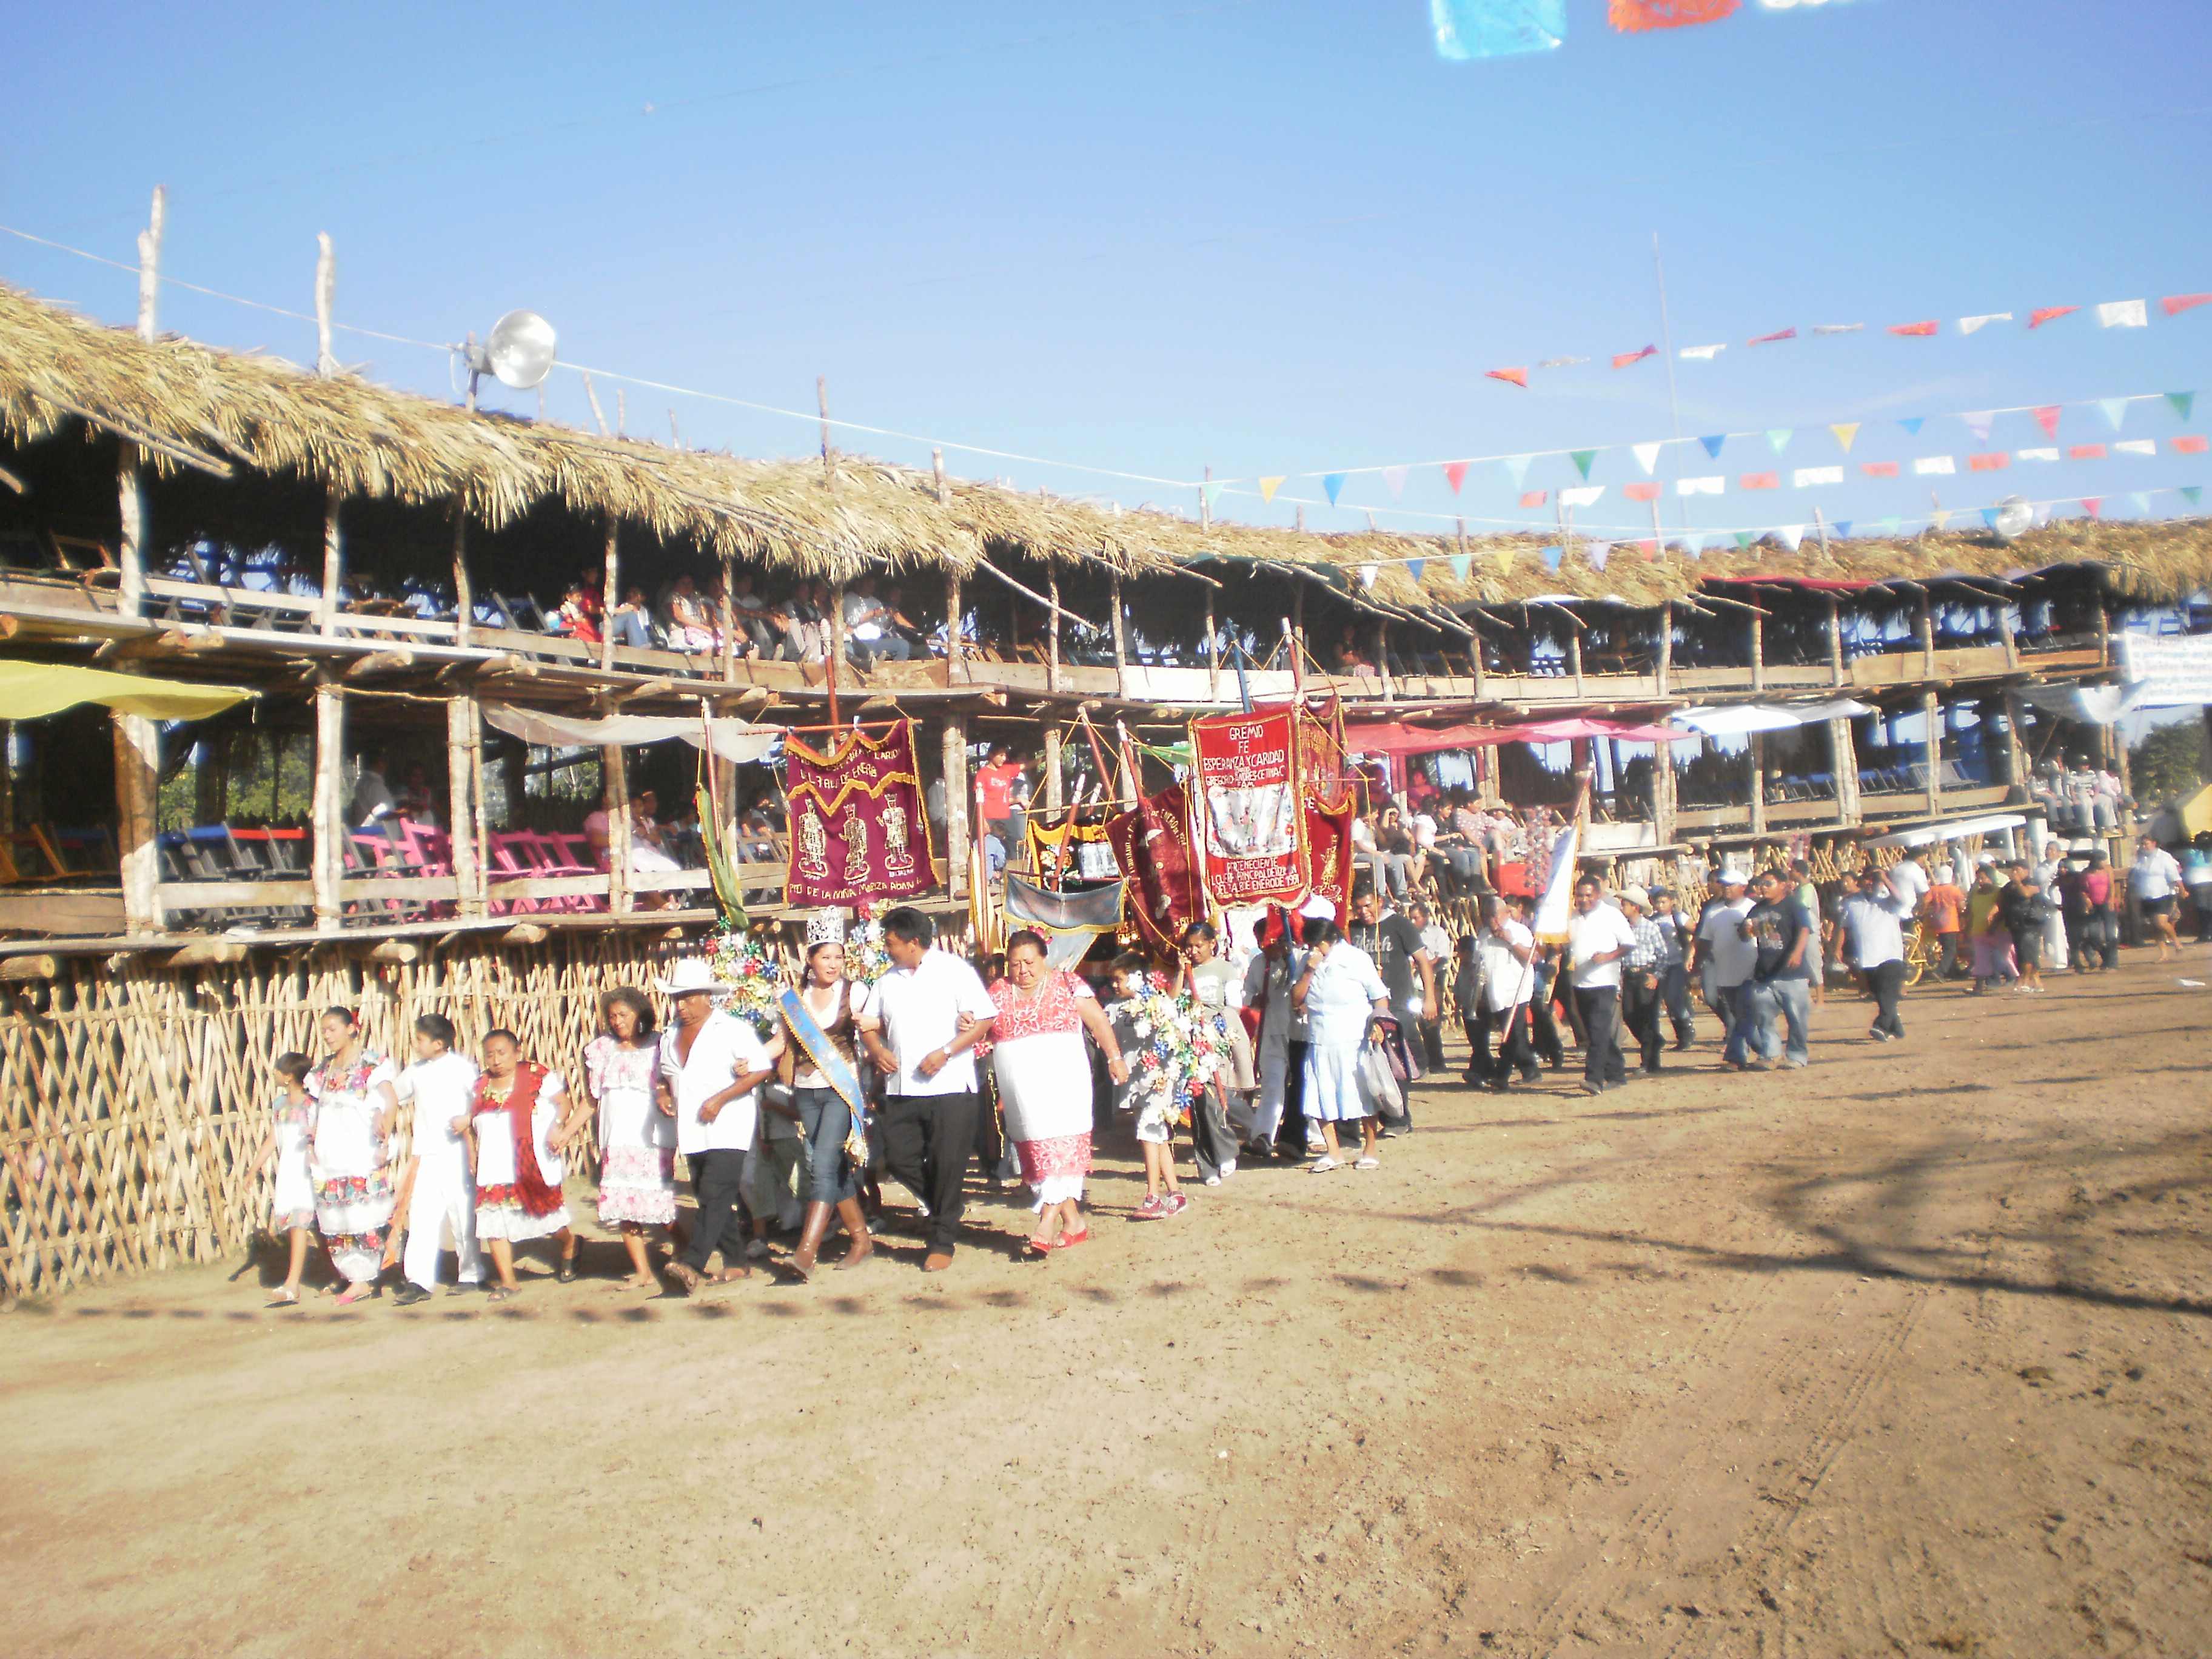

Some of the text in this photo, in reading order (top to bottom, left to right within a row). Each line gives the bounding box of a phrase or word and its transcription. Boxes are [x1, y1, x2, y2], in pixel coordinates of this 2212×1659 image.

[1230, 725, 1264, 740] GREMIO
[1238, 740, 1249, 754] FE
[1203, 756, 1244, 771] ESPERANZA
[1251, 749, 1285, 767] CARIDAD
[807, 886, 819, 897] DE
